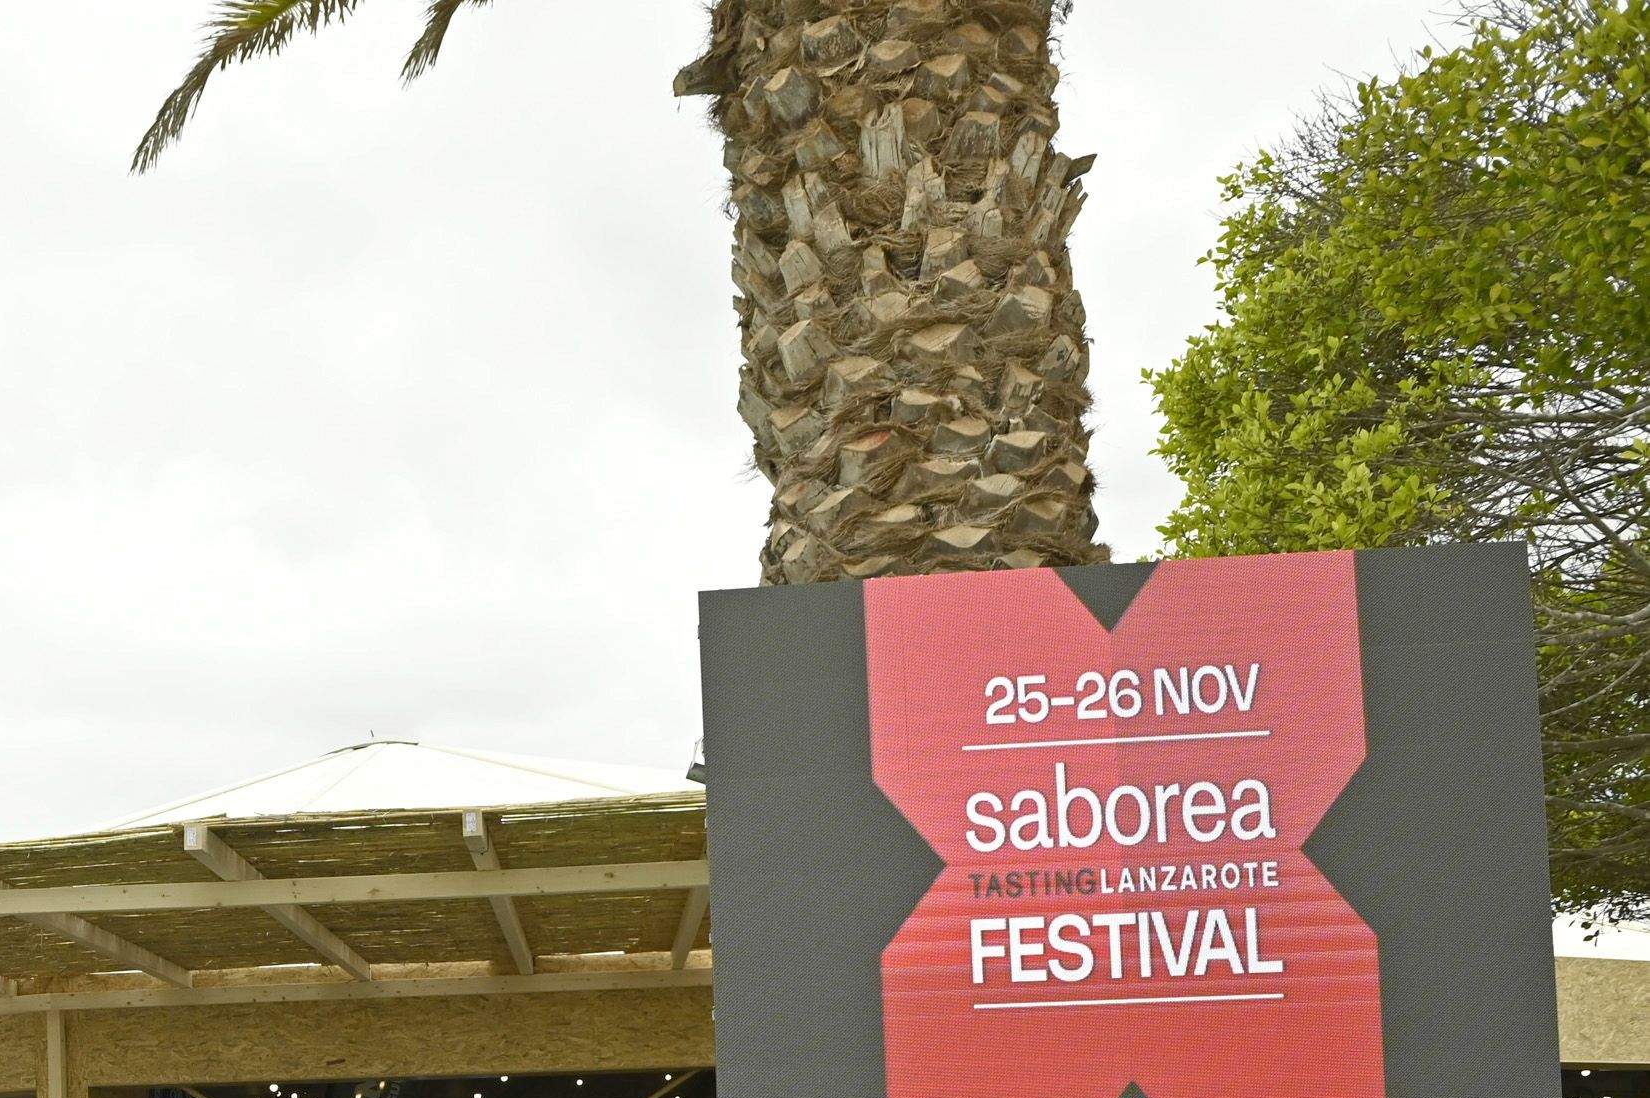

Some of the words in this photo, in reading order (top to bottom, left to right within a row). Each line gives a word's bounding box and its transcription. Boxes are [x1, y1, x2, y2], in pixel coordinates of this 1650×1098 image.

[984, 669, 1142, 725] 25-26
[1153, 663, 1260, 718] NOV
[965, 761, 1277, 853] saborea
[1100, 861, 1279, 894] LANZAROTE
[970, 907, 1285, 984] FESTIVAL
